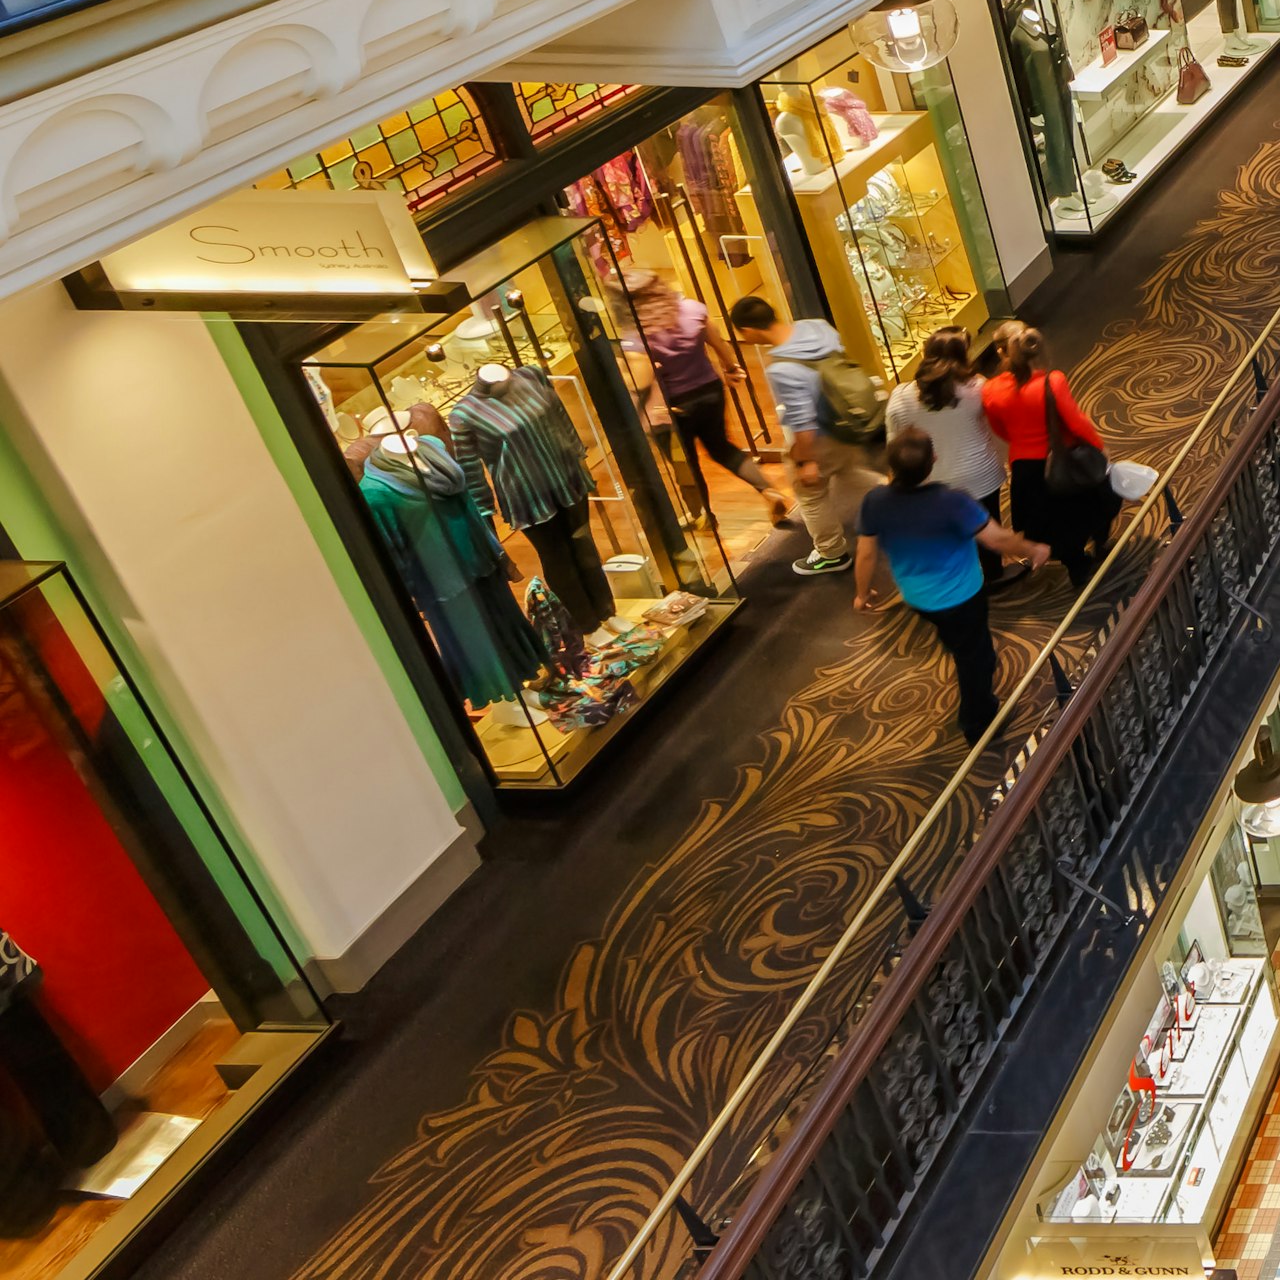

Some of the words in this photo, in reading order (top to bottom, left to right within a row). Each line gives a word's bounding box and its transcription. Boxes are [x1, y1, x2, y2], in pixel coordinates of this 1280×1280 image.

[189, 225, 384, 265] Smooth
[1061, 1266, 1115, 1276] RODD
[1118, 1266, 1131, 1276] &
[1134, 1266, 1189, 1276] GUNN
